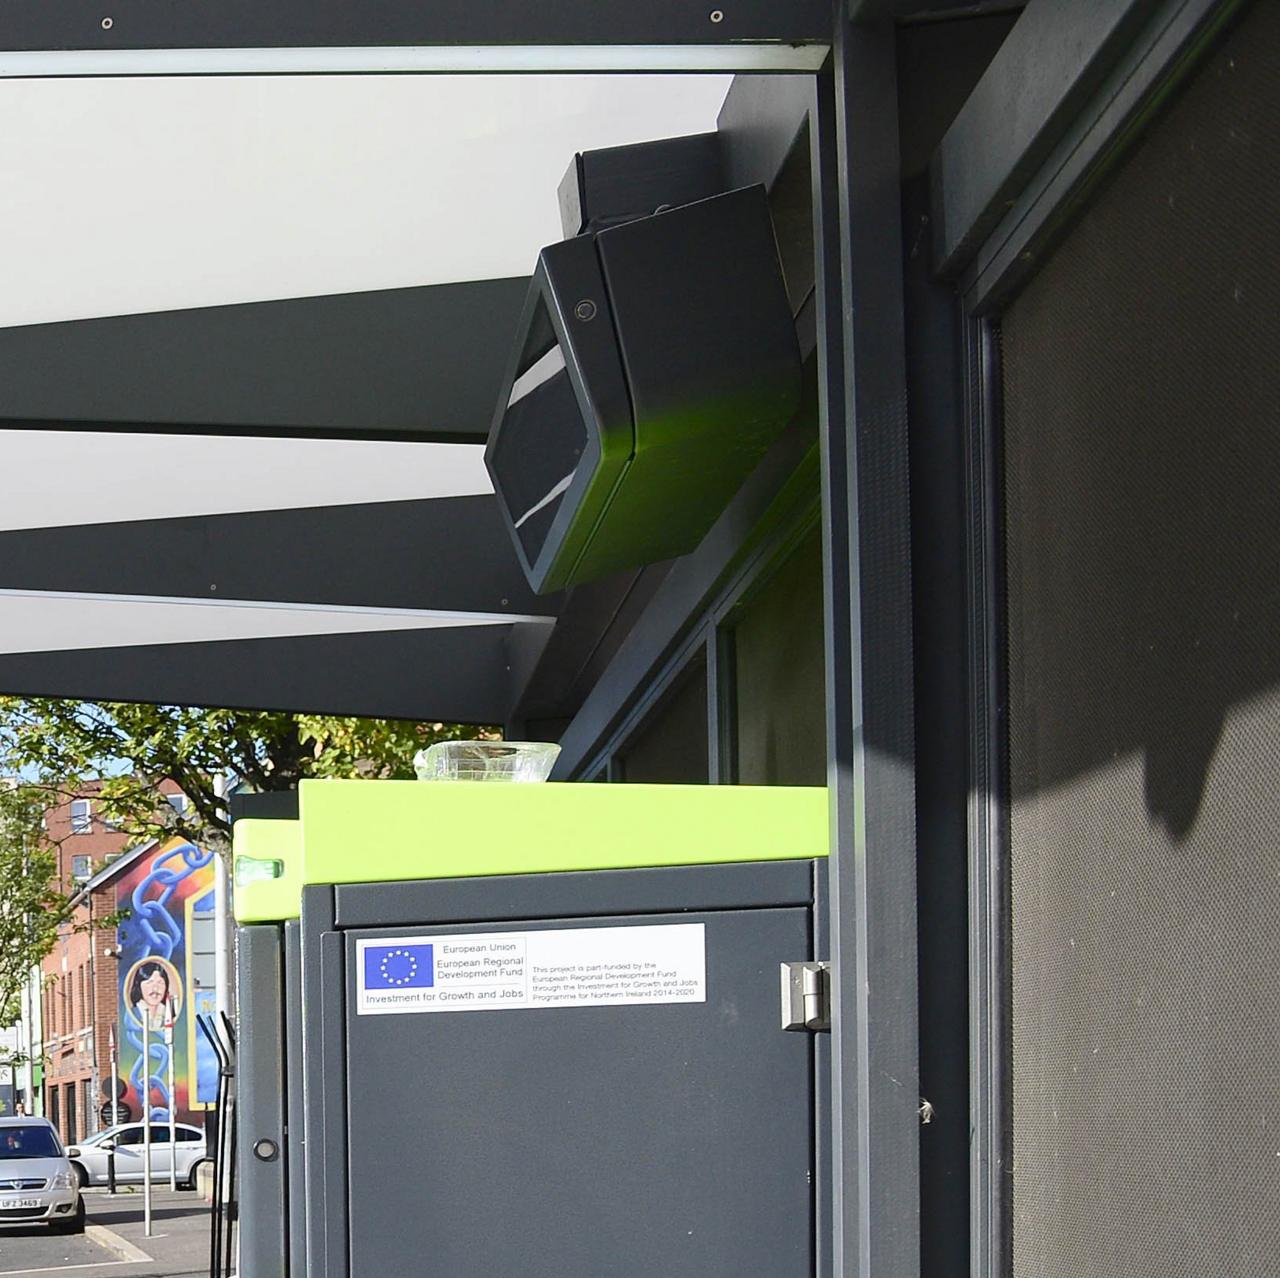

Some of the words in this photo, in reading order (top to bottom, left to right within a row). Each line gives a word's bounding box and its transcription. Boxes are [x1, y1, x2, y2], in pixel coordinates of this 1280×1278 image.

[443, 944, 487, 953] European
[489, 943, 516, 951] Union
[437, 959, 480, 969] European
[483, 957, 524, 967] Regional
[550, 965, 576, 974] project
[586, 964, 631, 973] part-funded
[633, 963, 642, 971] by
[437, 970, 498, 979] Development
[500, 968, 523, 976] Fund
[532, 975, 568, 983] European
[570, 974, 603, 982] Regional
[605, 972, 655, 980] Development
[657, 970, 677, 978] Fund
[532, 984, 562, 993] through
[577, 982, 619, 990] Investment
[633, 980, 661, 988] Growth
[663, 979, 678, 987] and
[366, 995, 420, 1003] Investment
[423, 992, 436, 1001] for
[439, 991, 475, 1000] Growth
[478, 990, 496, 998] and
[500, 989, 524, 998] Jobs
[532, 993, 576, 1002] Programme
[591, 991, 624, 999] Northern
